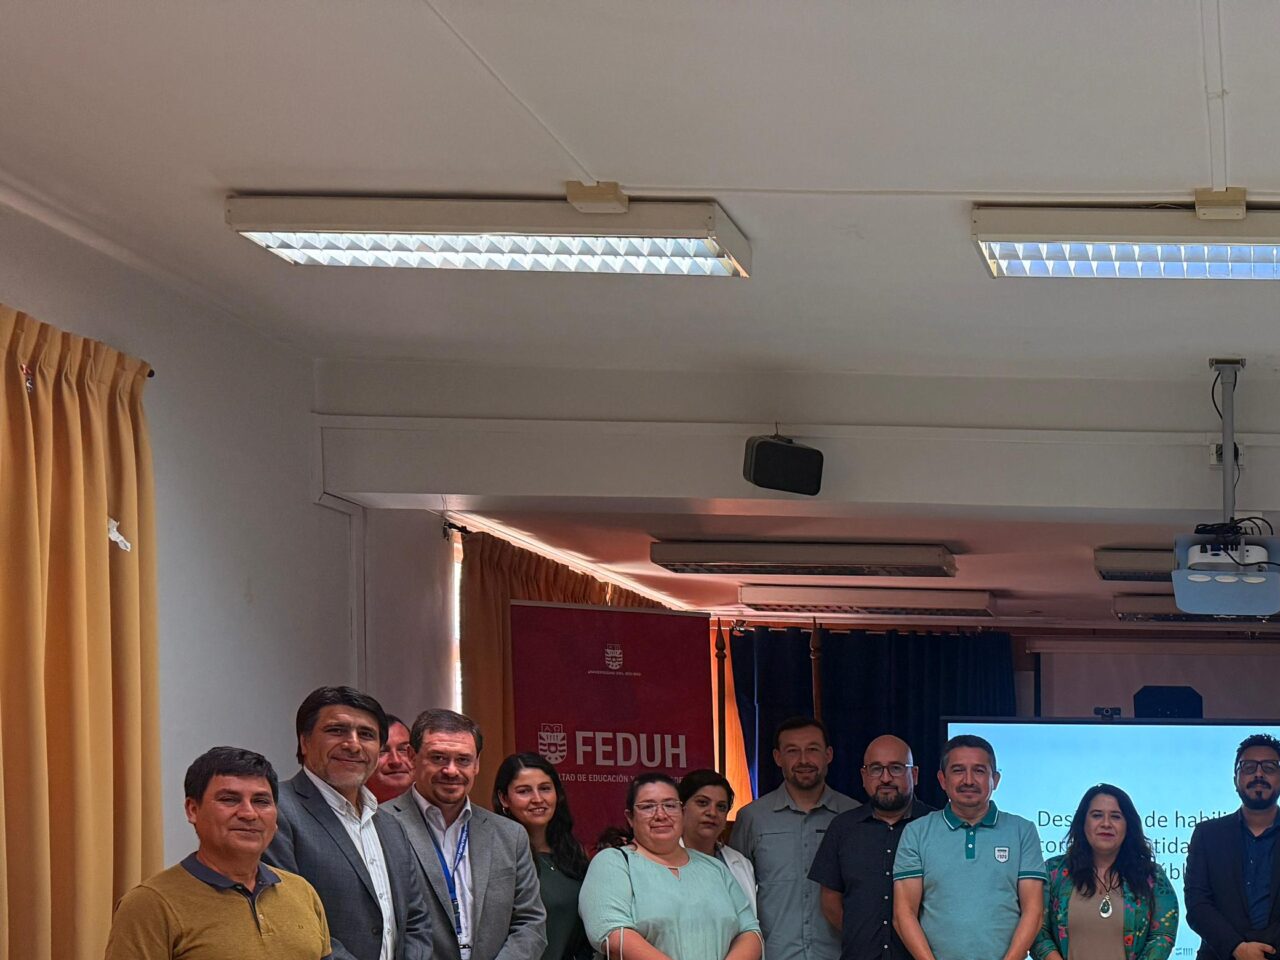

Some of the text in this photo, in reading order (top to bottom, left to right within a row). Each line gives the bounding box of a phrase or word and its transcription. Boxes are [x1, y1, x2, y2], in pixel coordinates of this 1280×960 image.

[576, 731, 687, 768] FEDUH
[558, 773, 576, 782] LTAD
[577, 774, 587, 782] DE
[588, 774, 629, 783] EDUCACIÓN
[1038, 810, 1073, 827] Des
[1145, 811, 1168, 827] de
[1154, 837, 1189, 853] tida
